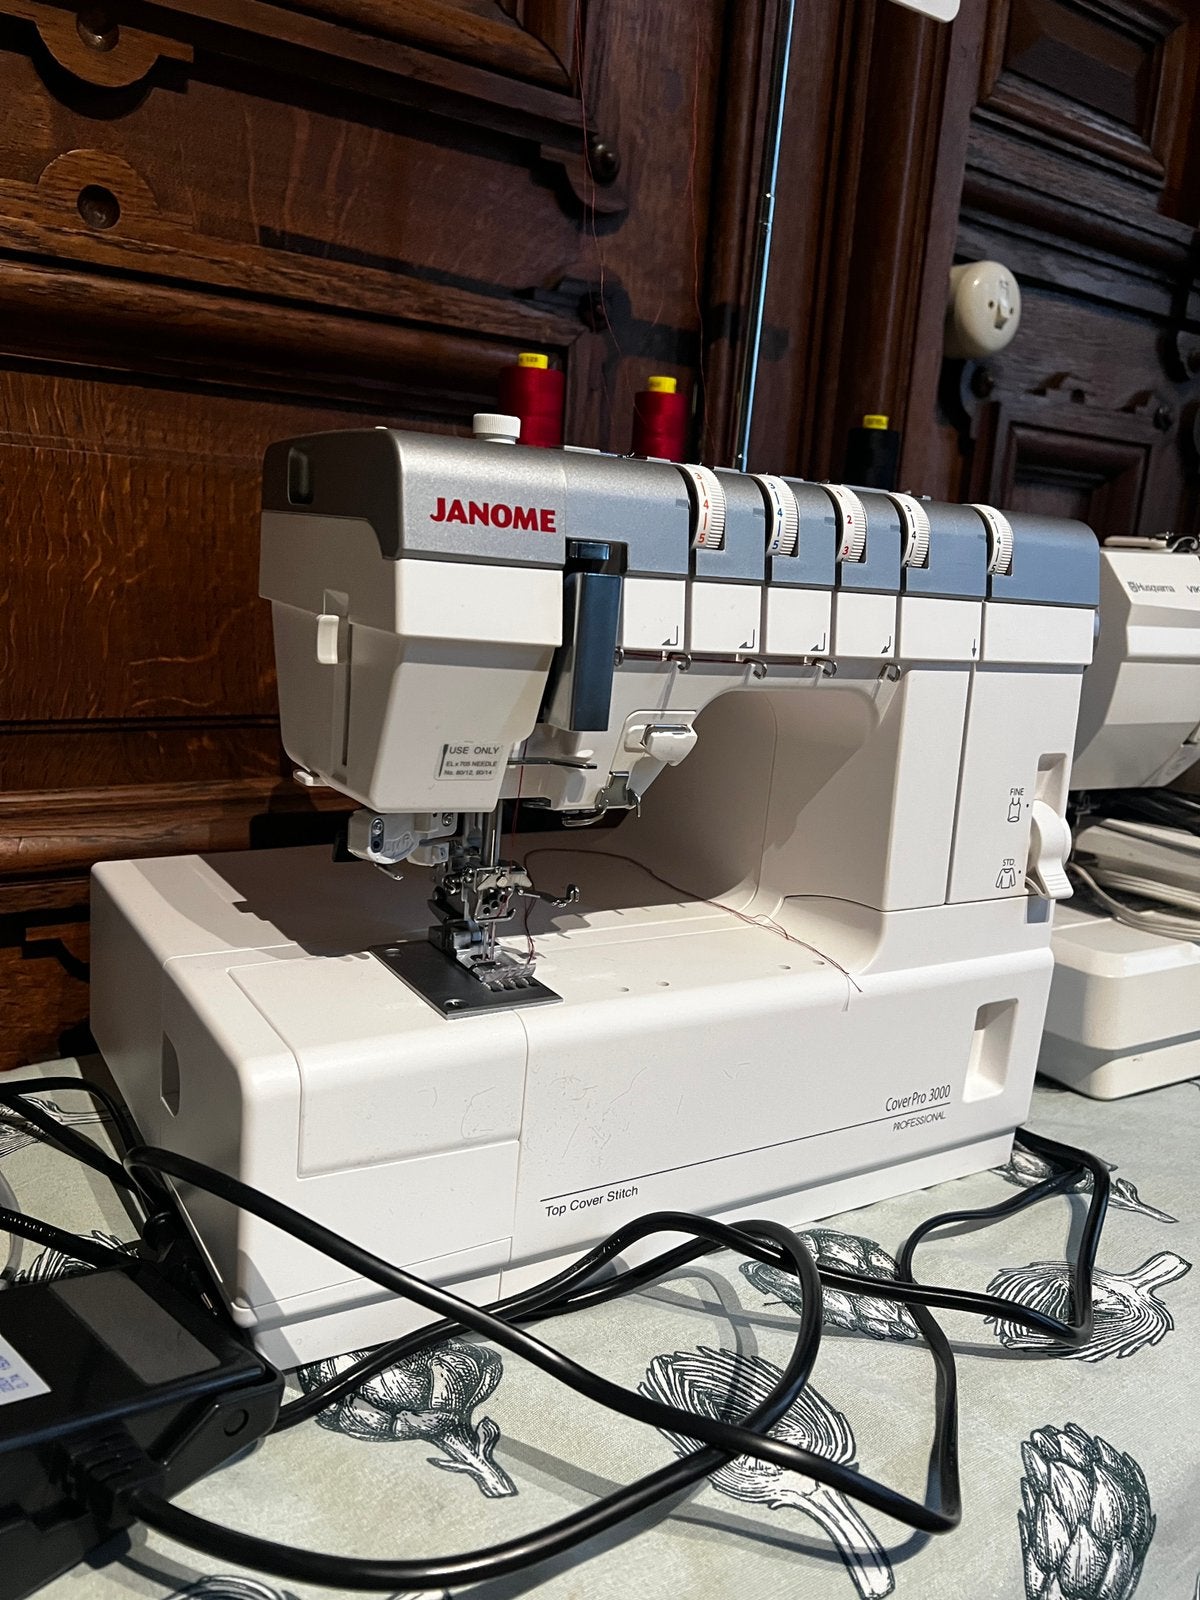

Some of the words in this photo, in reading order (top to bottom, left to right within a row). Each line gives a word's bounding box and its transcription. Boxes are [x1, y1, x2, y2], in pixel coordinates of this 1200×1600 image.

[703, 499, 709, 510] 4
[430, 497, 556, 533] JANOME
[777, 507, 783, 518] 4
[846, 514, 853, 525] 2
[698, 533, 706, 544] 5
[911, 529, 917, 540] 4
[772, 539, 779, 550] 5
[996, 537, 1002, 546] 4
[842, 545, 850, 556] 3
[989, 564, 997, 573] 5
[449, 746, 469, 755] USE
[474, 746, 500, 755] ONLY
[1009, 787, 1025, 796] FINE
[928, 1084, 951, 1102] 3000
[892, 1111, 946, 1131] PROFESSIONAL
[545, 1205, 567, 1217] Top
[569, 1195, 604, 1211] Cover
[607, 1186, 639, 1202] Stitch
